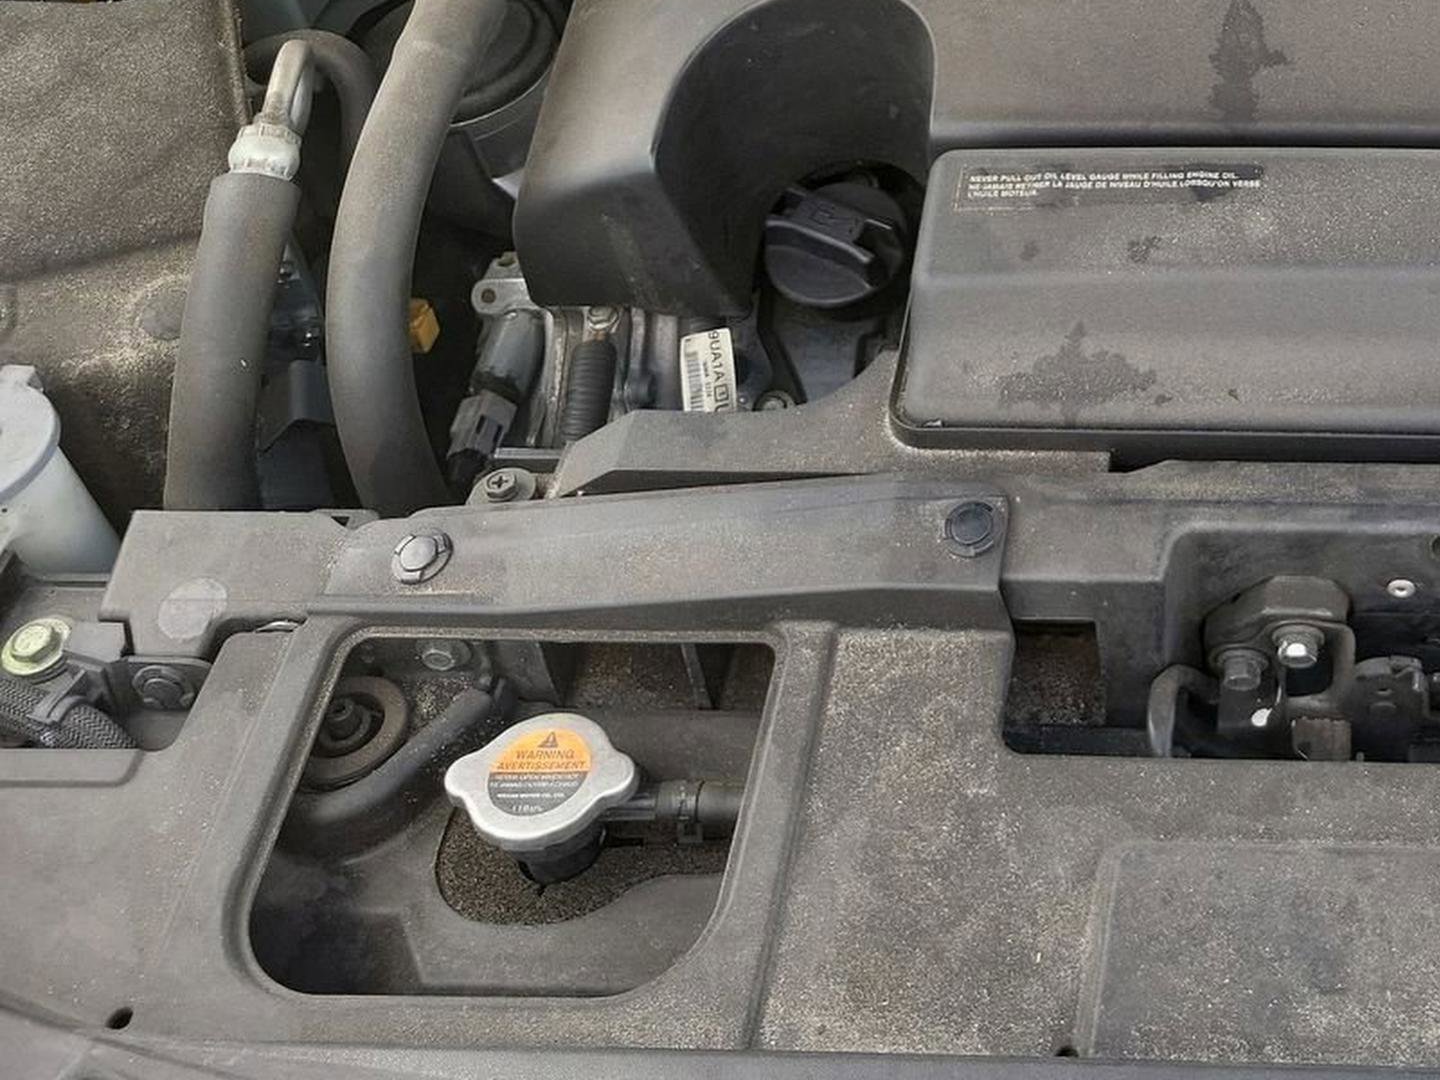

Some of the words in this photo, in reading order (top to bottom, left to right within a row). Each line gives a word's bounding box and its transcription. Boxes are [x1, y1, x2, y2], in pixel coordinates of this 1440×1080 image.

[968, 174, 998, 182] NEVER
[1000, 174, 1021, 182] PULL
[1023, 173, 1042, 182] OUT
[1043, 172, 1058, 180] OIL
[1060, 172, 1087, 180] LEVEL
[1089, 172, 1120, 180] GAUGE
[1122, 172, 1149, 180] WHILE
[1186, 170, 1219, 179] ENGINE
[1064, 181, 1093, 189] JAUGE
[1108, 180, 1141, 188] NIVEAU
[515, 749, 576, 760] WARNING
[496, 760, 586, 770] AVERTISSEMENT
